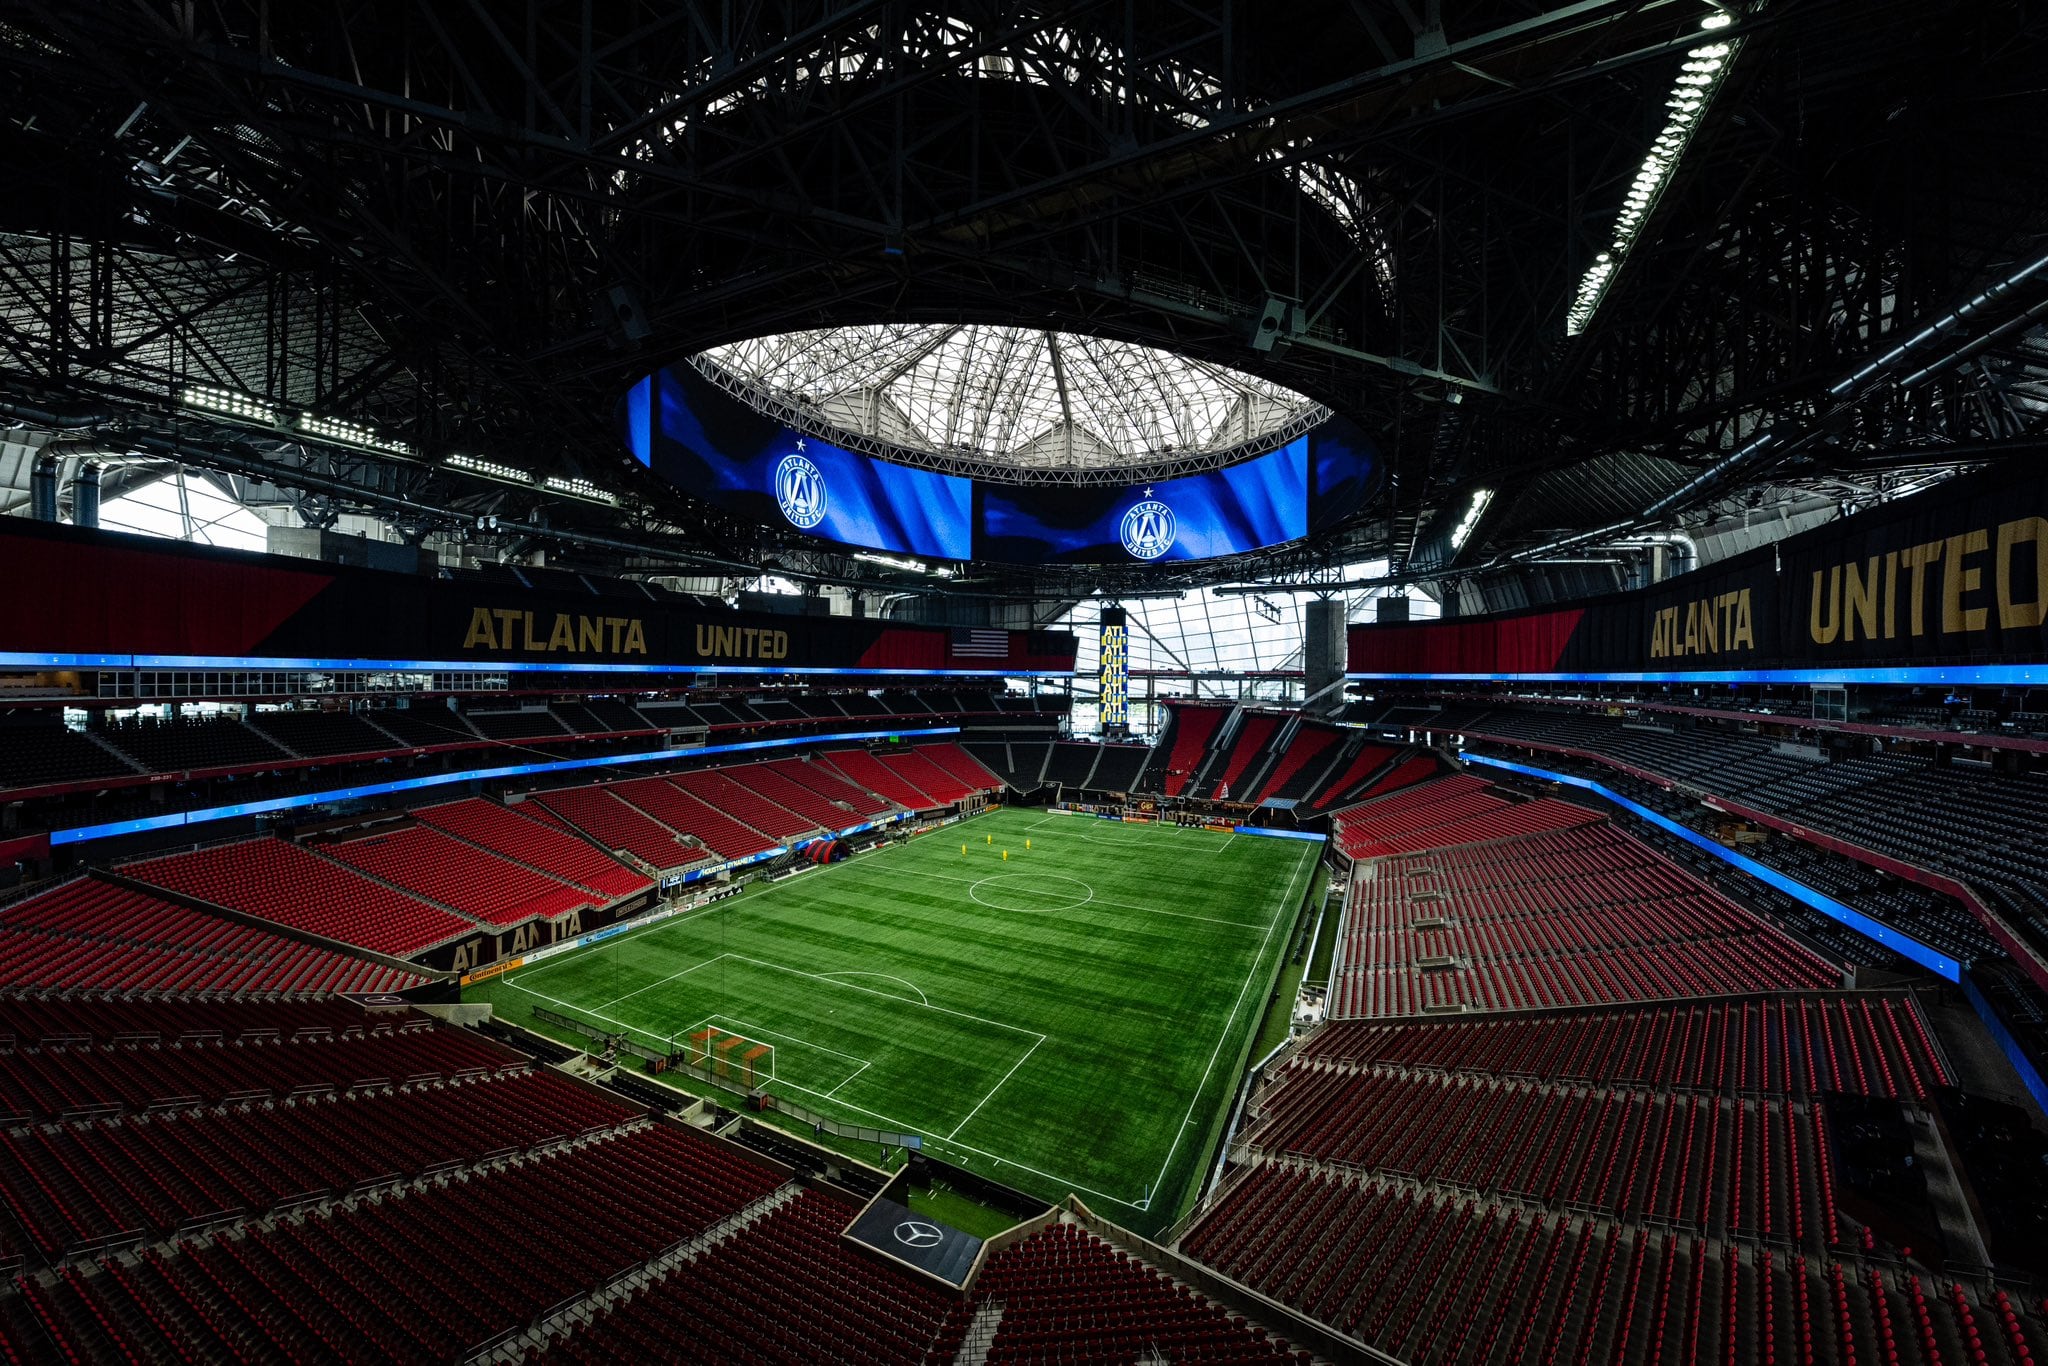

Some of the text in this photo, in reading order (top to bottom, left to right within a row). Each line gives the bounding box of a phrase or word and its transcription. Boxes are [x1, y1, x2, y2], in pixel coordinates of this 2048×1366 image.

[783, 458, 820, 481] ATLANTA
[781, 500, 822, 526] UNITED FC
[1129, 503, 1169, 519] ATLANTA
[1127, 539, 1170, 557] UNITED FC
[1650, 516, 2048, 659] ATLANTA UNITED
[462, 606, 789, 660] ATLANTA UNITED
[1105, 626, 1126, 636] ATL
[1105, 645, 1126, 655] ATL
[1104, 664, 1126, 675] ATL
[1104, 684, 1126, 693] ATL
[1104, 703, 1126, 713] ATL
[703, 862, 727, 875] HOUSTON
